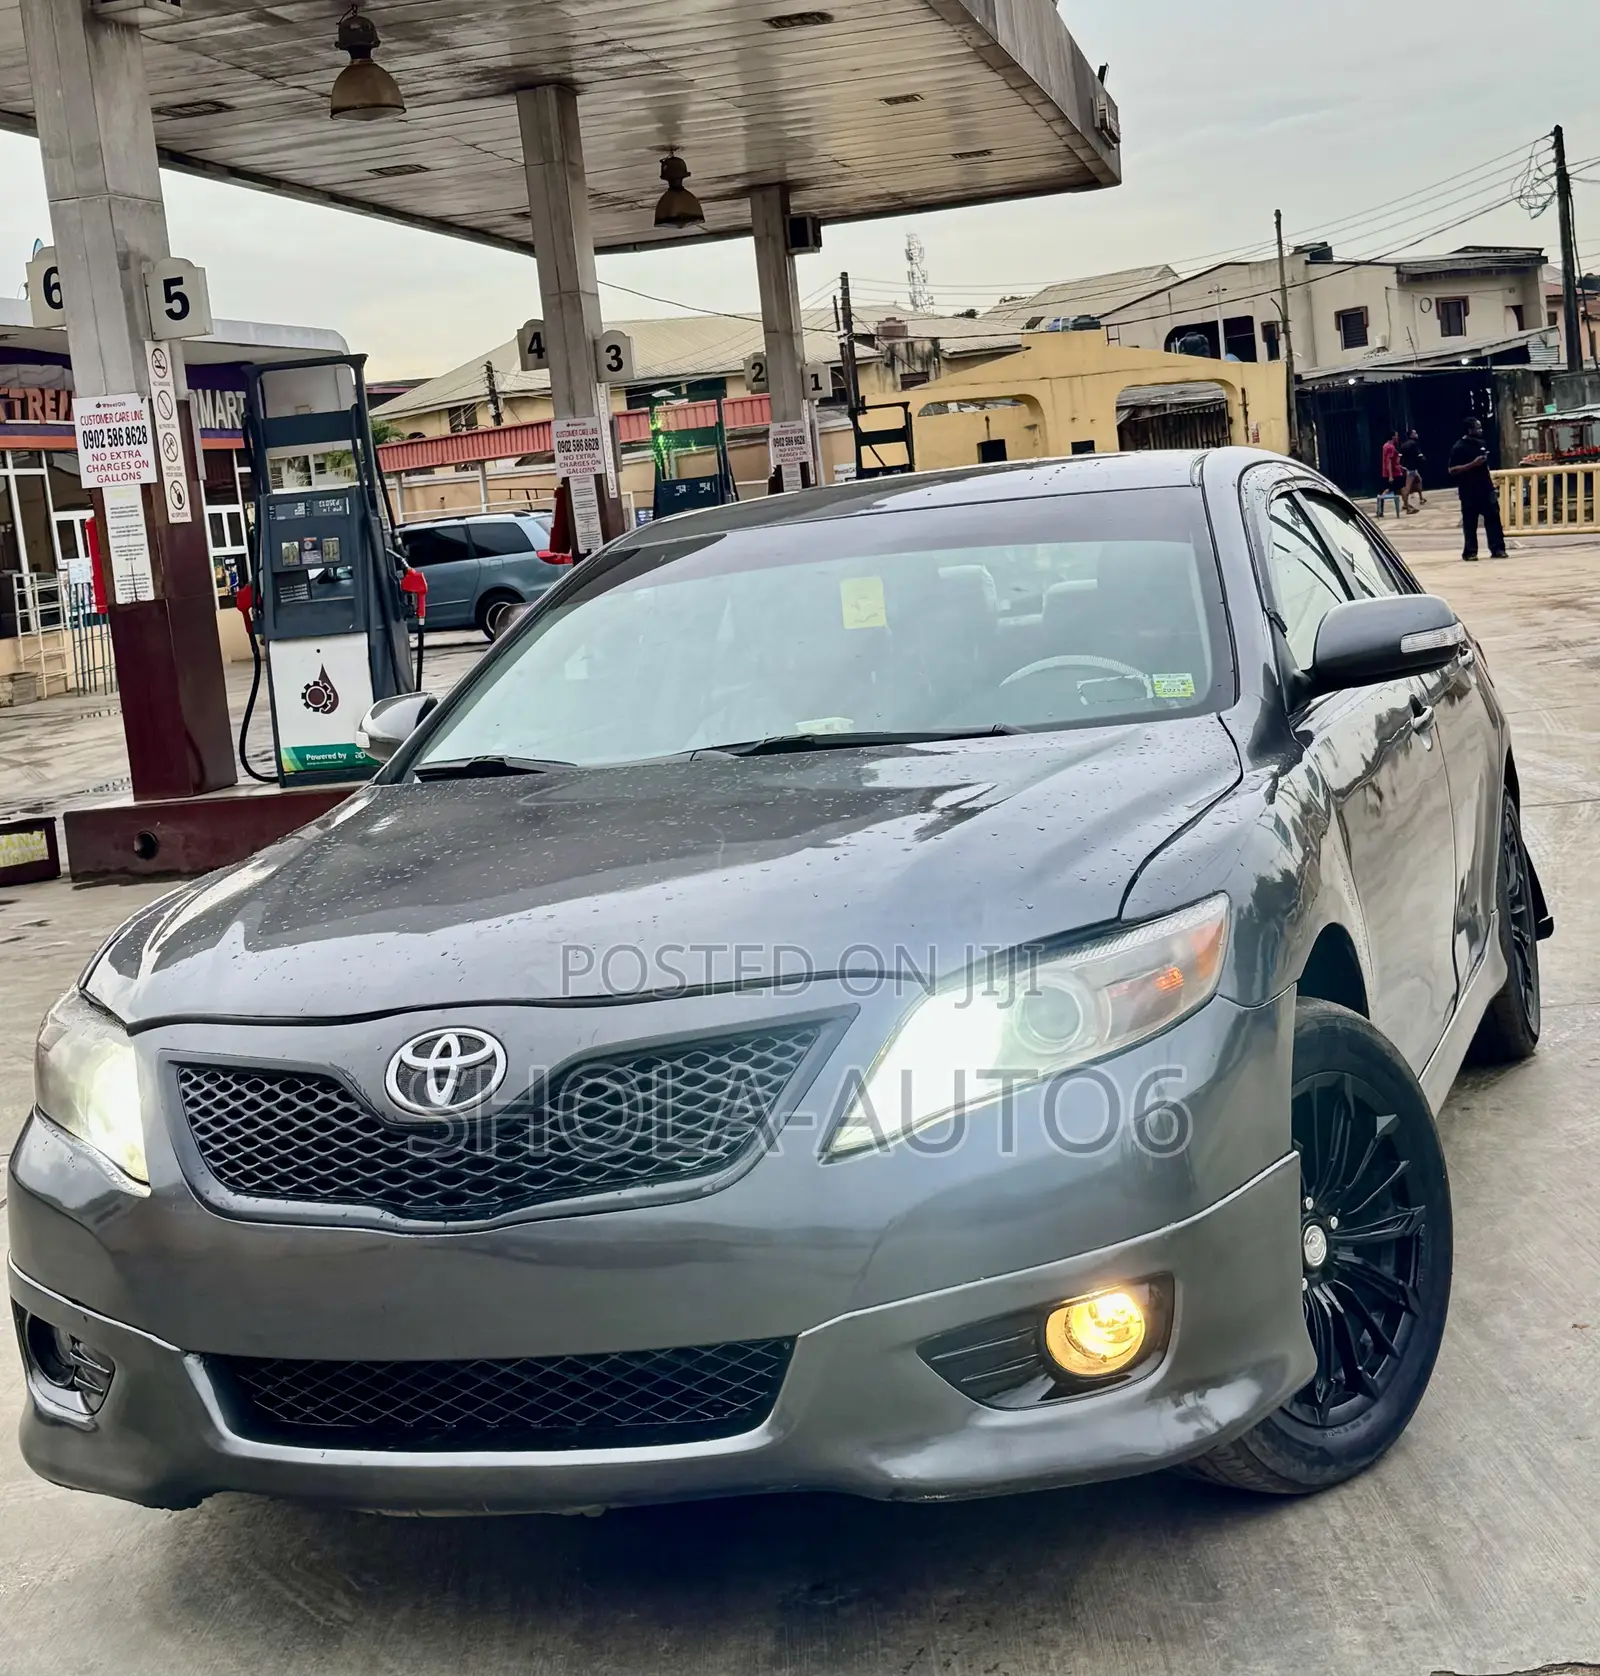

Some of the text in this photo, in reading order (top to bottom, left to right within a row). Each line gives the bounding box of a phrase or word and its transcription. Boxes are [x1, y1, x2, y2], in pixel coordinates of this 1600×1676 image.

[42, 266, 63, 310] 6
[162, 276, 190, 321] 5
[527, 331, 546, 360] 4
[605, 344, 624, 372] 3
[751, 361, 765, 383] 2
[811, 373, 822, 392] 1
[80, 410, 144, 426] CUSTOMER CARE LINE
[197, 388, 246, 429] MART
[82, 425, 148, 449] 0902 586 8628
[86, 460, 149, 473] CHARGES ON
[92, 449, 141, 462] NO EXTRA
[96, 471, 142, 483] GALLONS
[305, 752, 337, 761] Powered
[337, 751, 347, 760] by
